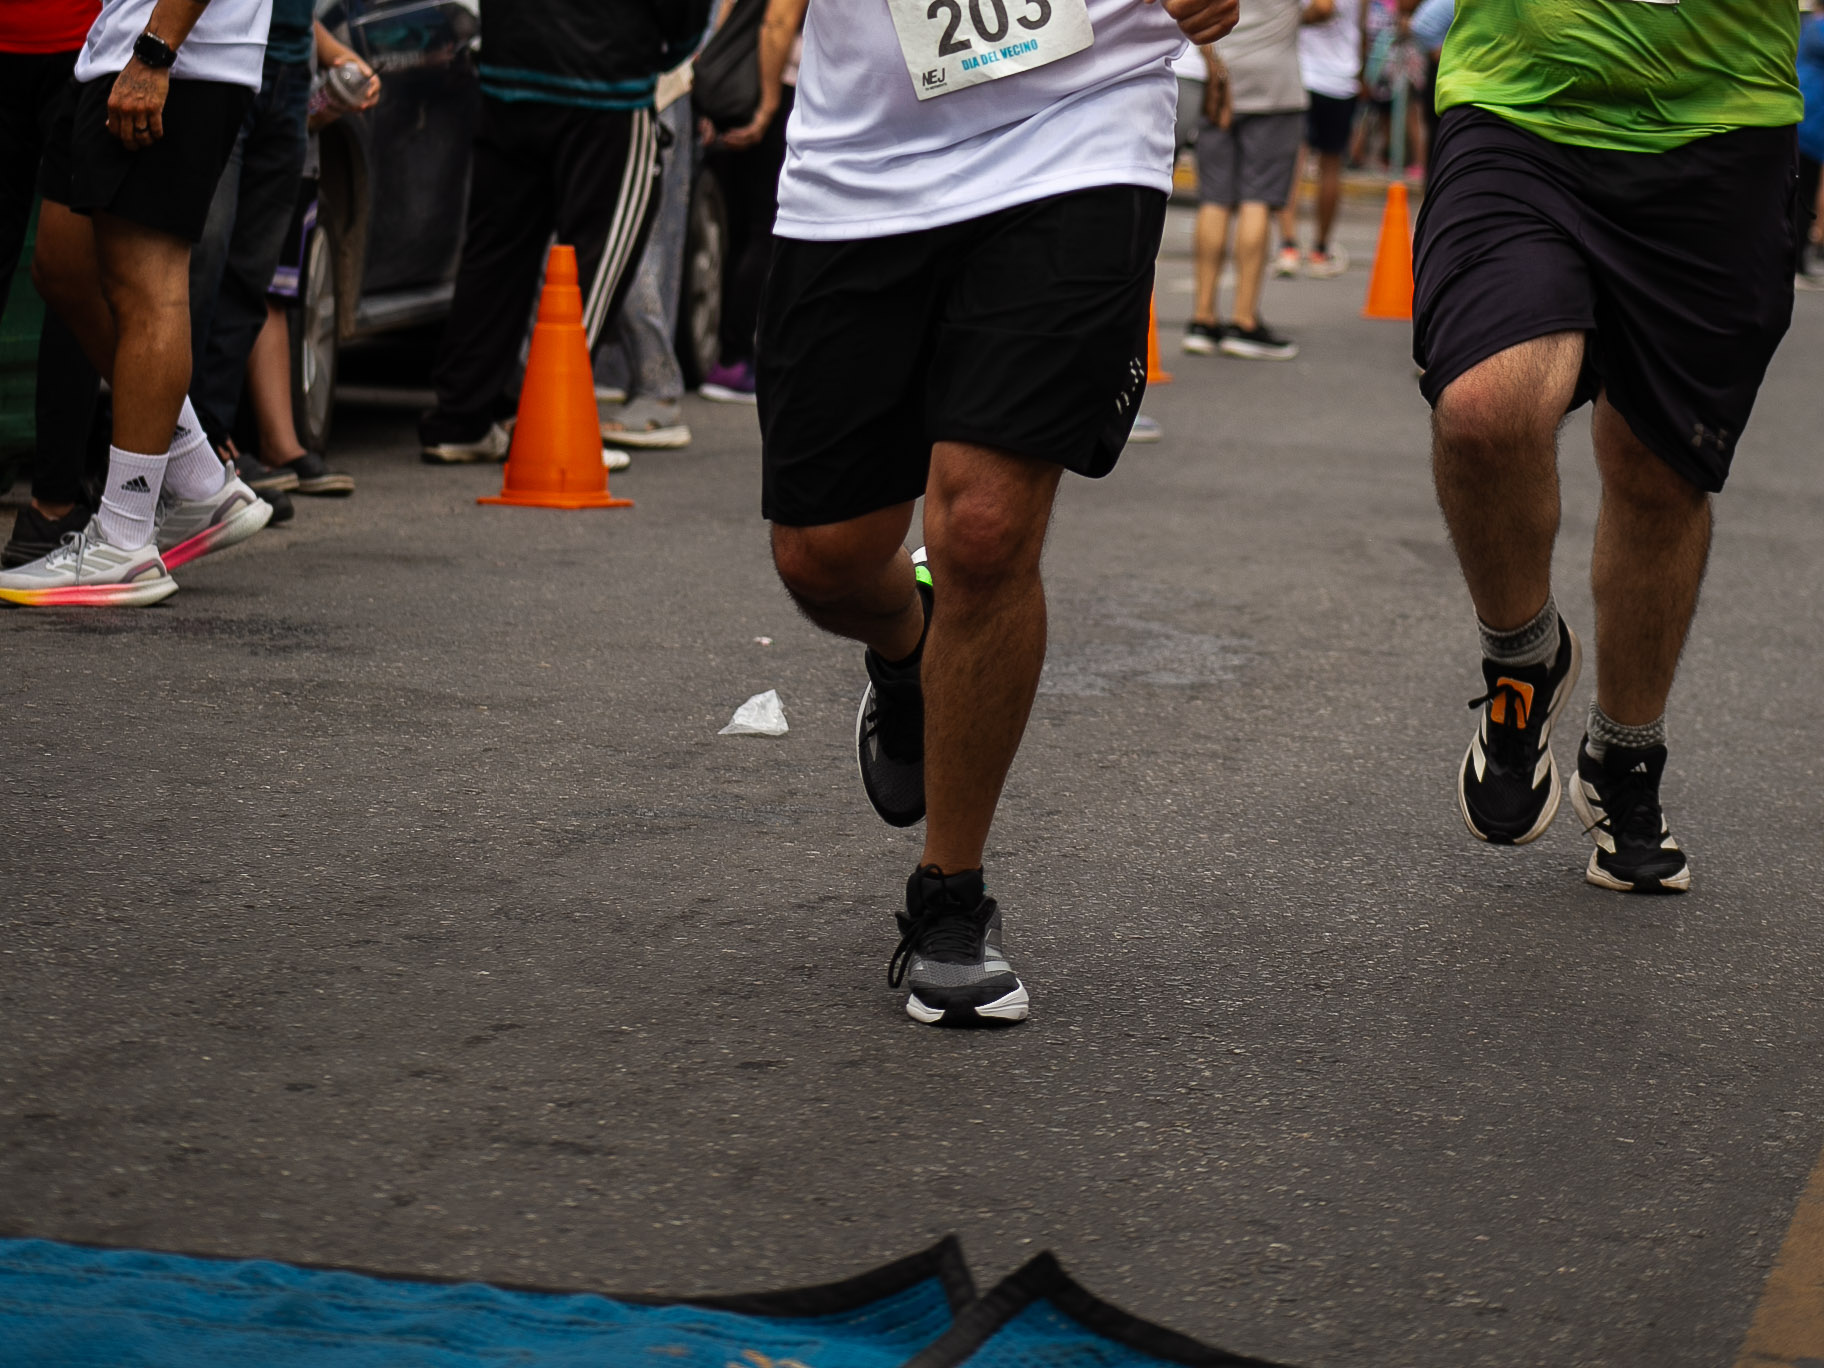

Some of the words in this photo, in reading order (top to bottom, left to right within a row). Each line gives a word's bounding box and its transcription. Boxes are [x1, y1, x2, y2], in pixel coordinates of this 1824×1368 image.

[961, 57, 980, 71] DIA
[982, 53, 1000, 66] DEL
[1001, 38, 1039, 59] VECINO
[922, 67, 945, 87] NEJ
